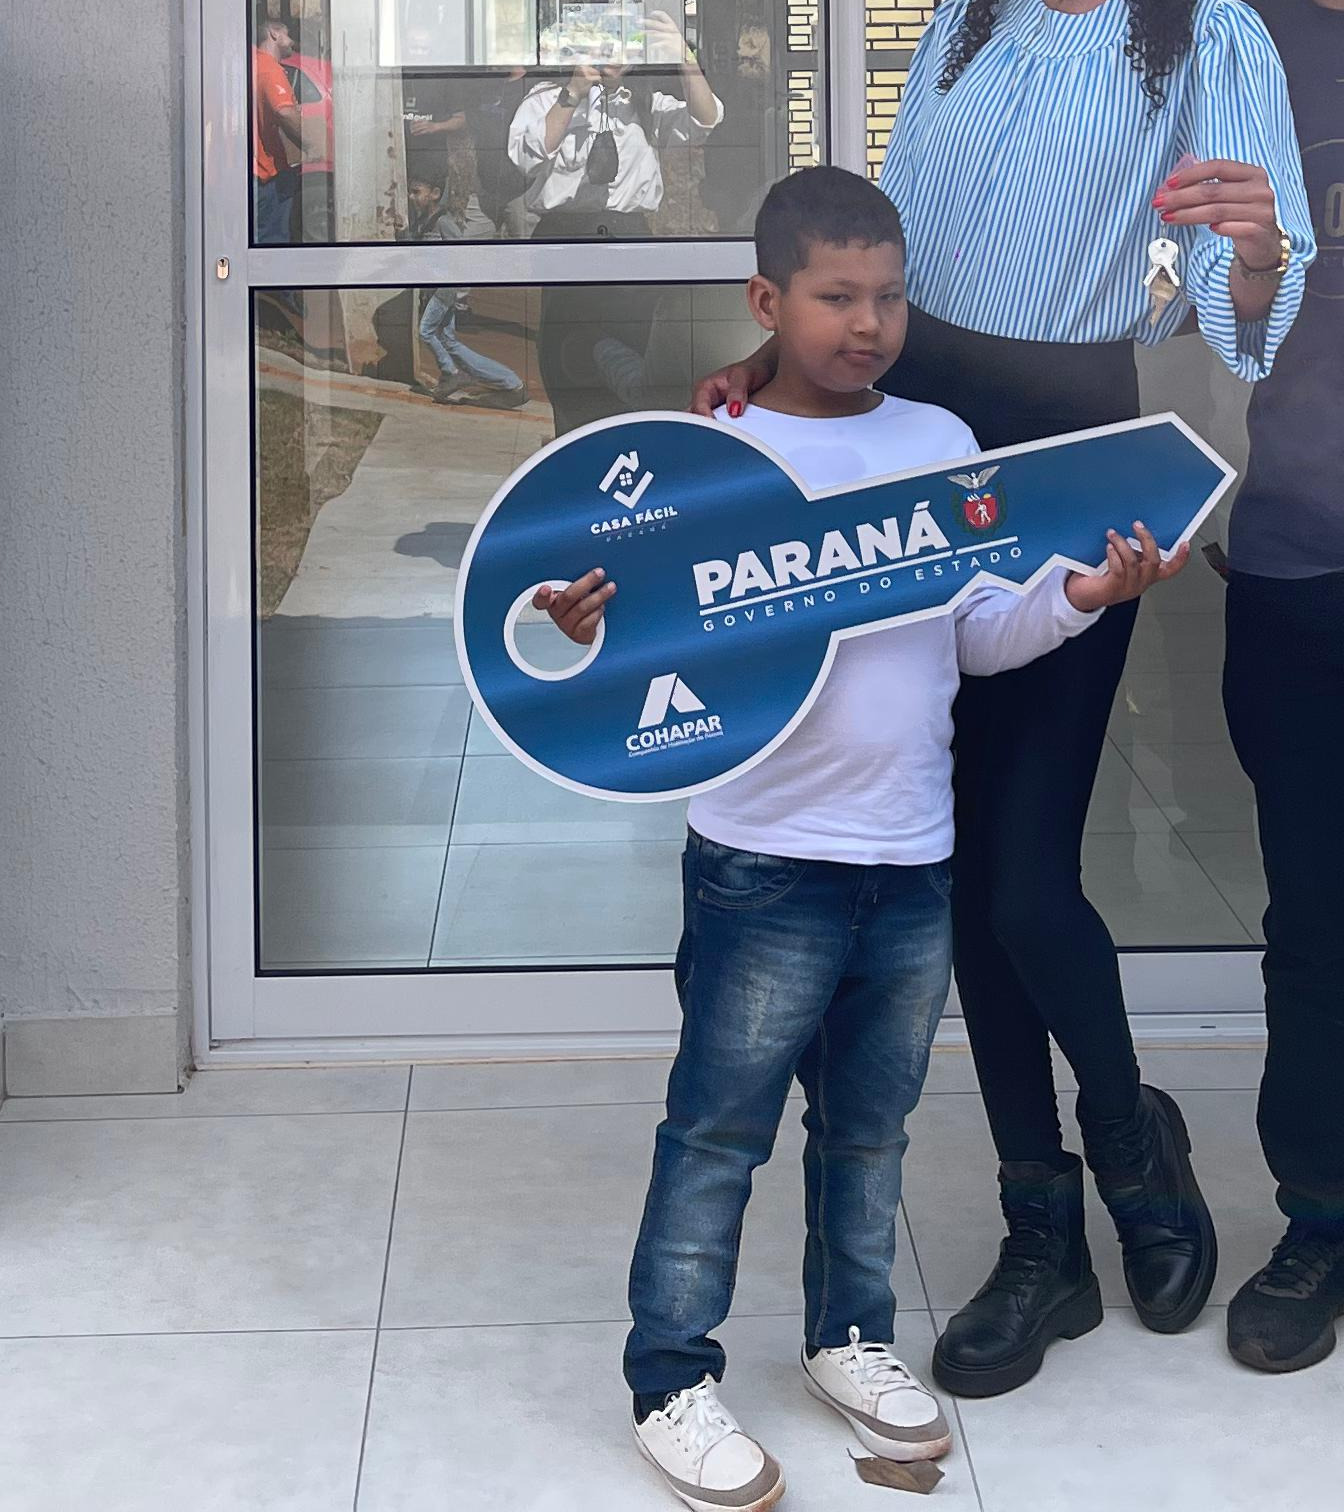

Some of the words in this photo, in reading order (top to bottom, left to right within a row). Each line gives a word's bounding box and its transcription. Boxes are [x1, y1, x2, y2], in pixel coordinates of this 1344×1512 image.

[590, 516, 632, 535] CASA
[635, 505, 678, 525] FÁCIL
[692, 500, 951, 606] PARANÁ
[703, 590, 836, 632] GOVERNO
[859, 576, 892, 595] DO
[914, 546, 1022, 581] ESTADO
[625, 714, 723, 751] COHAPAR
